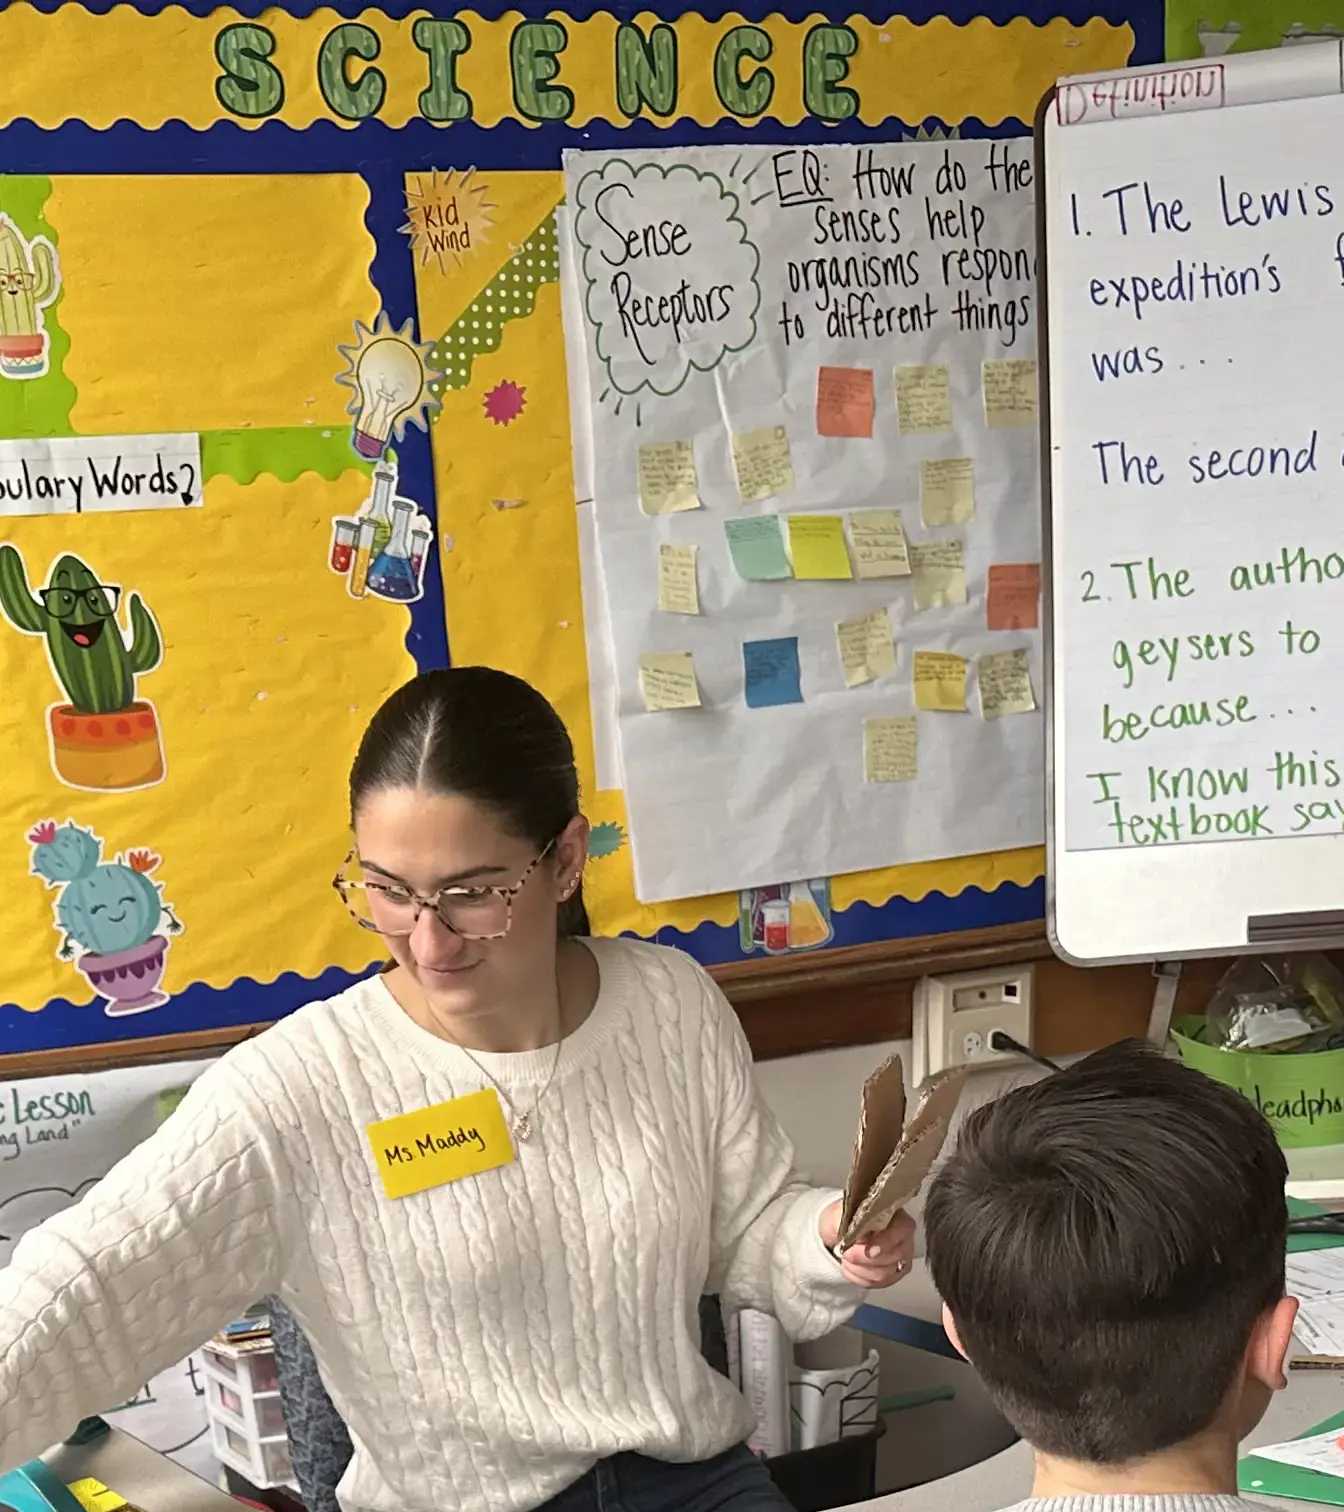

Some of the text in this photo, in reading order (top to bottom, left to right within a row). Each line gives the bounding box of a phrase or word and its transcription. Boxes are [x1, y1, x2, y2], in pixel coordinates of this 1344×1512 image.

[213, 20, 863, 122] SCIENCE
[772, 143, 1033, 201] EQ: How do the
[594, 182, 692, 267] Sense
[813, 196, 984, 247] senses help
[1104, 182, 1191, 235] The
[1219, 176, 1334, 229] Lewis
[431, 224, 471, 254] Wind
[787, 248, 1038, 311] organisms respon
[1090, 254, 1283, 320] expedition's
[609, 270, 734, 366] Receptors
[778, 289, 1031, 347] to different things
[86, 452, 178, 499] Words
[1093, 442, 1166, 486] The
[1188, 431, 1317, 483] second
[1111, 556, 1196, 601] The
[1113, 625, 1255, 689] geysers
[1278, 618, 1321, 656] to
[1086, 771, 1122, 806] I
[1148, 765, 1250, 803] know
[1273, 750, 1341, 792] this
[1107, 800, 1274, 846] textbook
[10, 1087, 96, 1125] Lesson
[414, 1127, 487, 1158] Maddy
